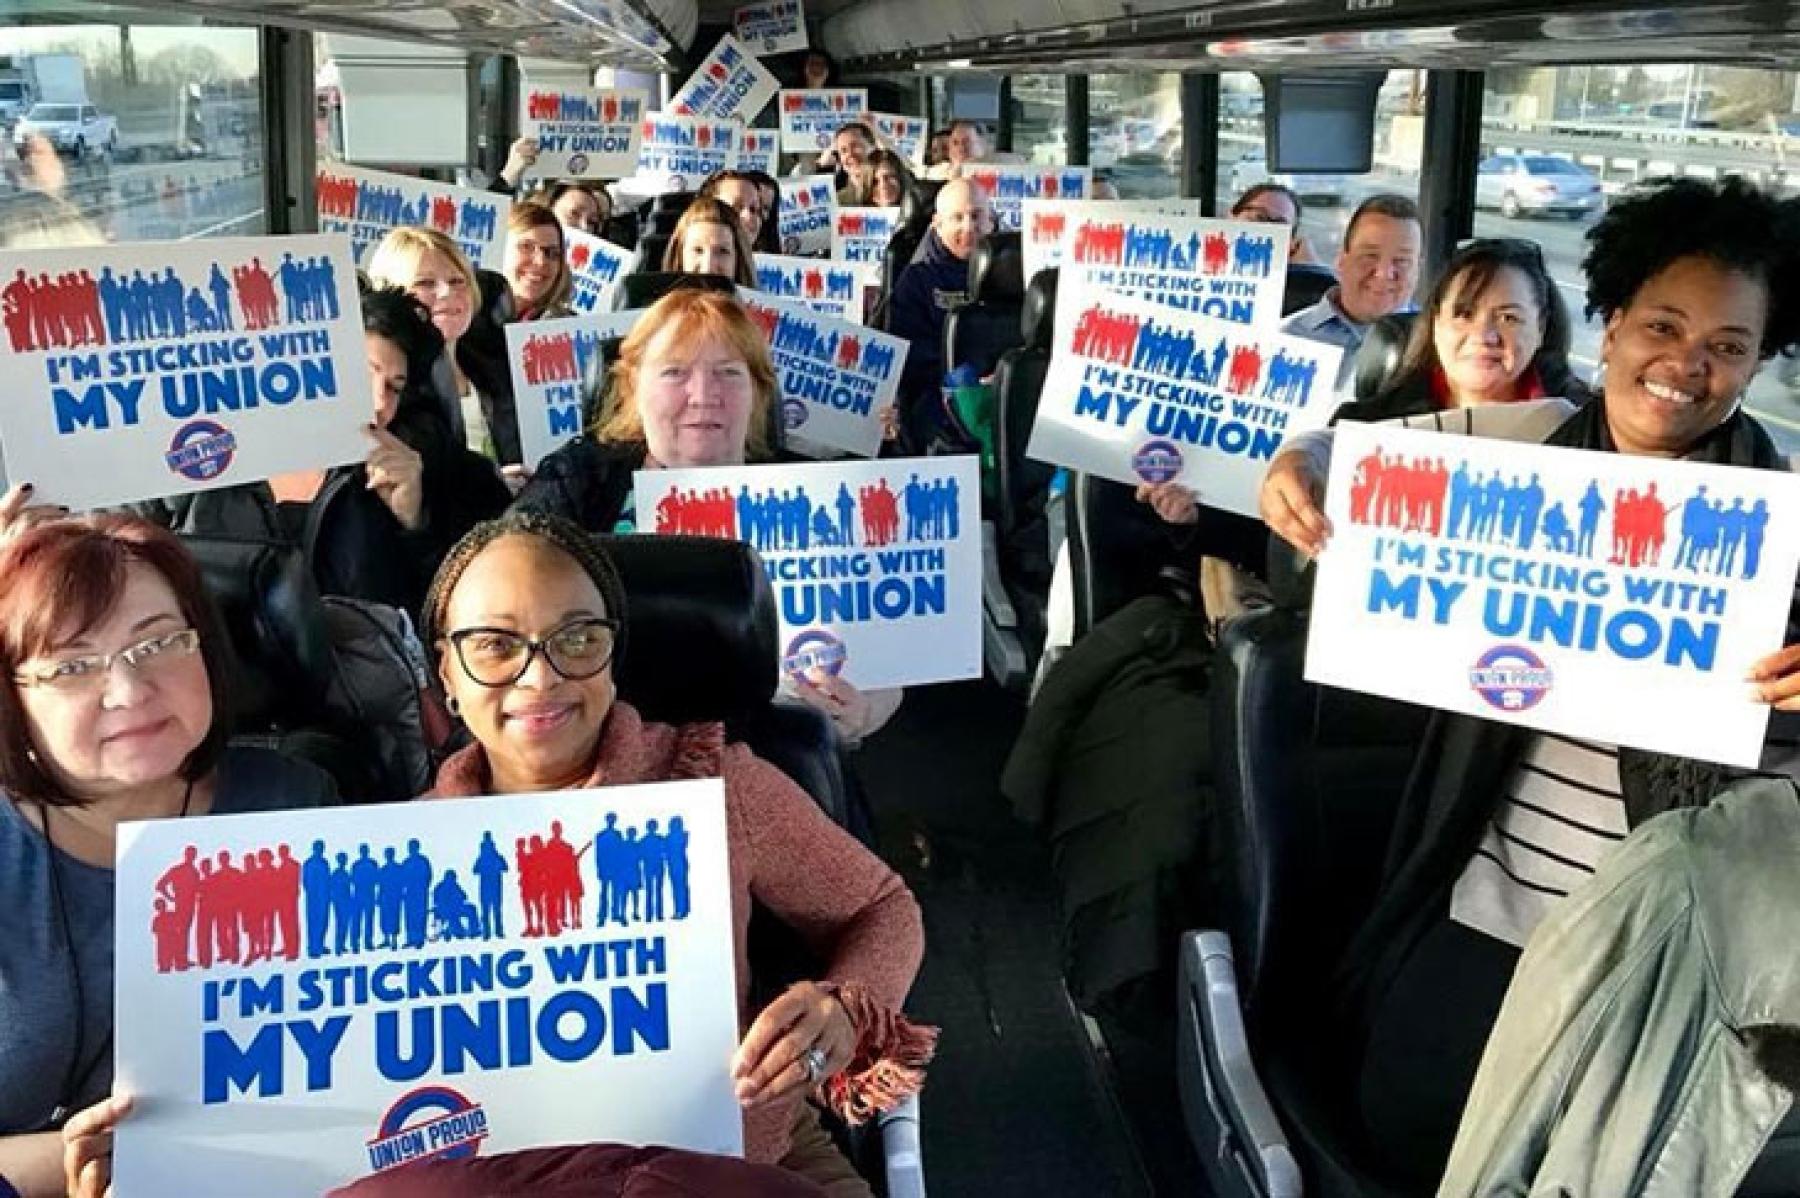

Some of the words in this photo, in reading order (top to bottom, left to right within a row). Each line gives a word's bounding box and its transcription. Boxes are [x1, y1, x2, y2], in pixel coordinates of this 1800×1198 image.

[540, 136, 567, 151] MY
[572, 136, 629, 151] UNION
[1119, 271, 1204, 293] STICKING
[1210, 279, 1257, 297] WITH
[46, 350, 102, 384] I'M
[109, 336, 253, 378] STICKING
[259, 329, 331, 360] WITH
[51, 378, 146, 435] MY
[161, 356, 338, 417] UNION
[545, 385, 574, 405] I'M
[548, 404, 579, 437] M
[784, 371, 873, 417] UNION
[1075, 384, 1141, 426] MY
[1146, 401, 1284, 461] UNION
[1085, 364, 1118, 388] I'M
[1121, 373, 1225, 413] STICKING
[1232, 398, 1288, 429] WITH
[877, 546, 945, 575] WITH
[1374, 536, 1426, 569] I'M
[1438, 547, 1611, 599] STICKING
[1623, 572, 1728, 617] WITH
[782, 573, 946, 628] UNION
[1366, 567, 1468, 626] MY
[1482, 587, 1722, 673] UNION
[203, 973, 284, 1024] I'M
[298, 948, 533, 1012] STICKING
[544, 935, 668, 984] WITH
[202, 1014, 353, 1106] MY
[374, 981, 671, 1082] UNION
[369, 1130, 426, 1170] UNION
[428, 1107, 488, 1150] PROUD
